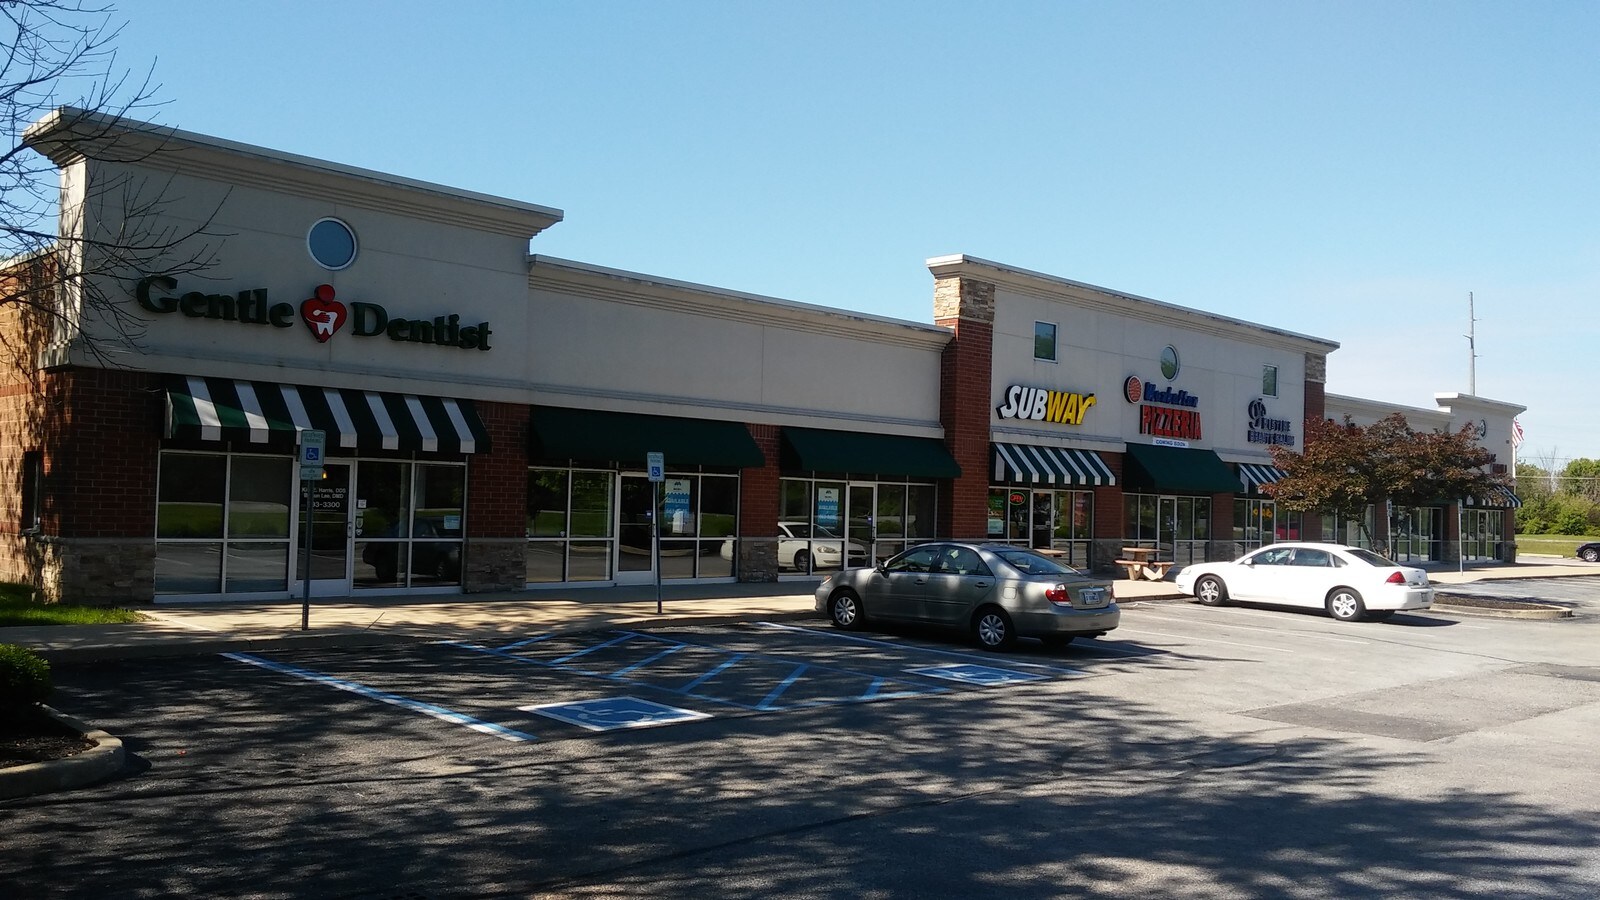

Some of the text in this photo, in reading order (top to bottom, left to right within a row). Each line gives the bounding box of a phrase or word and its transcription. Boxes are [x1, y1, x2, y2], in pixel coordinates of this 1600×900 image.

[136, 275, 492, 350] Gentle Dentist
[996, 385, 1097, 425] SUBWAY
[1139, 405, 1202, 440] PIZZERIA
